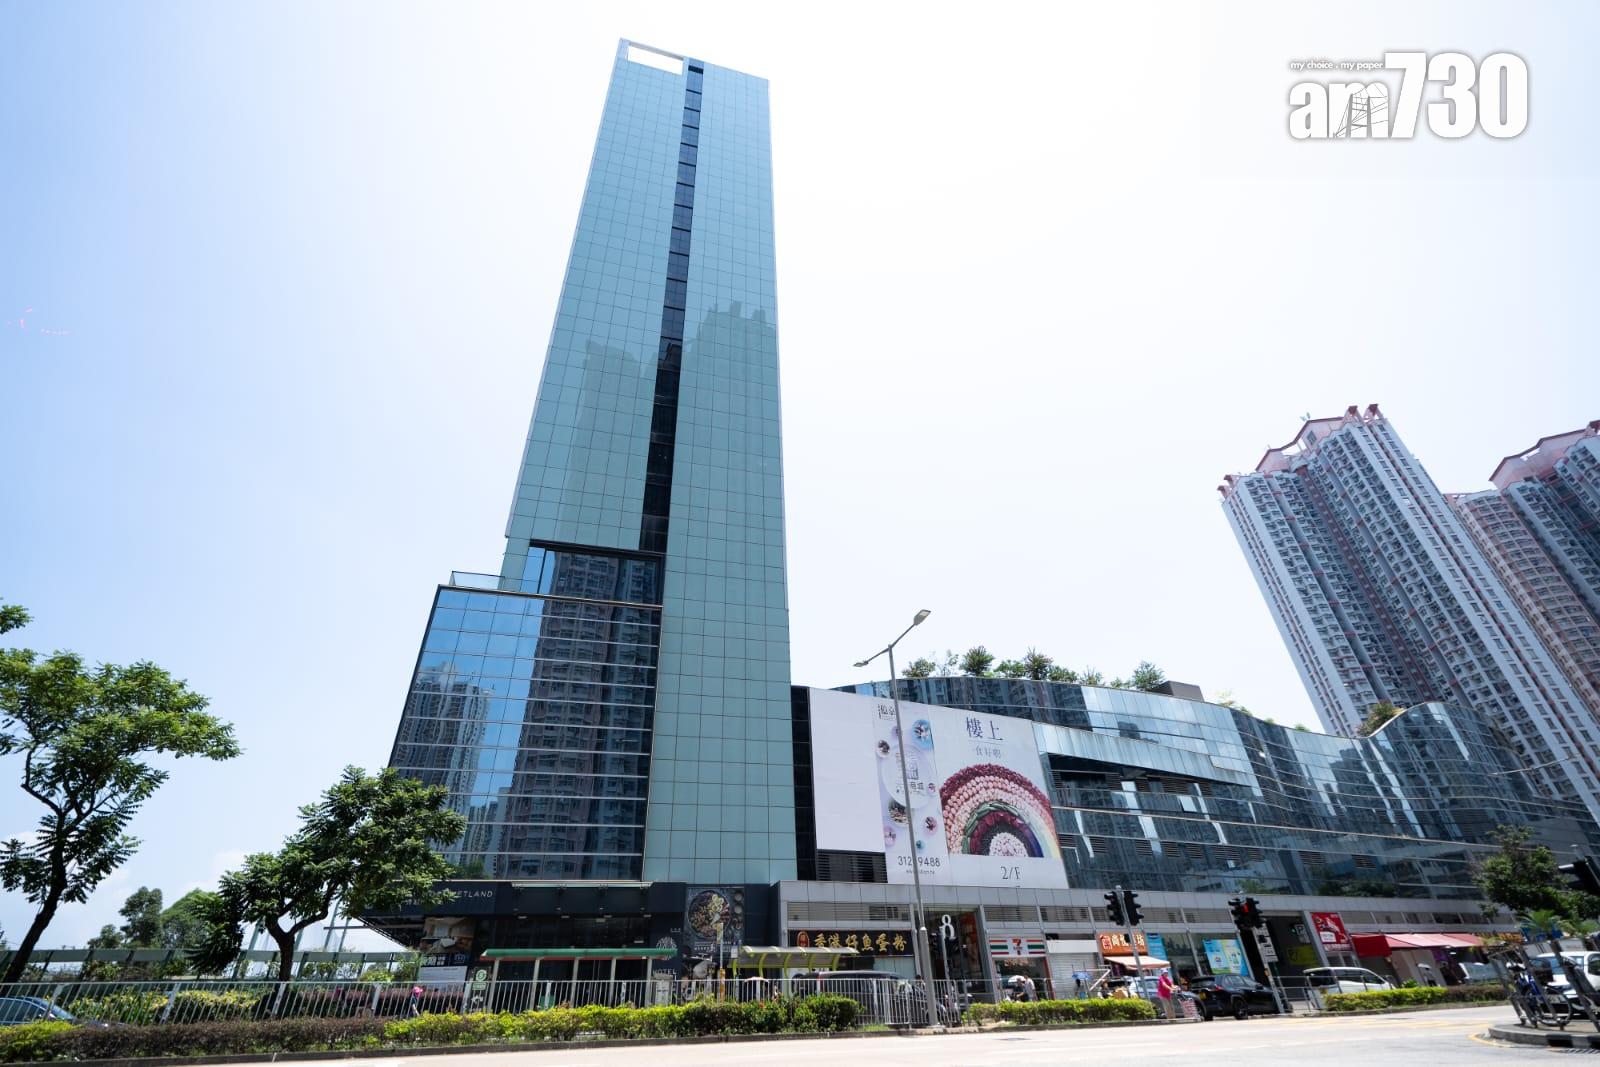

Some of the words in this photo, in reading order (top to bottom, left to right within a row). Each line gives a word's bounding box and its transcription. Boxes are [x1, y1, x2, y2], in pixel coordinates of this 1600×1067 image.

[966, 716, 1003, 741] 樓上
[898, 856, 940, 867] 3129488
[1000, 866, 1021, 880] 2/F
